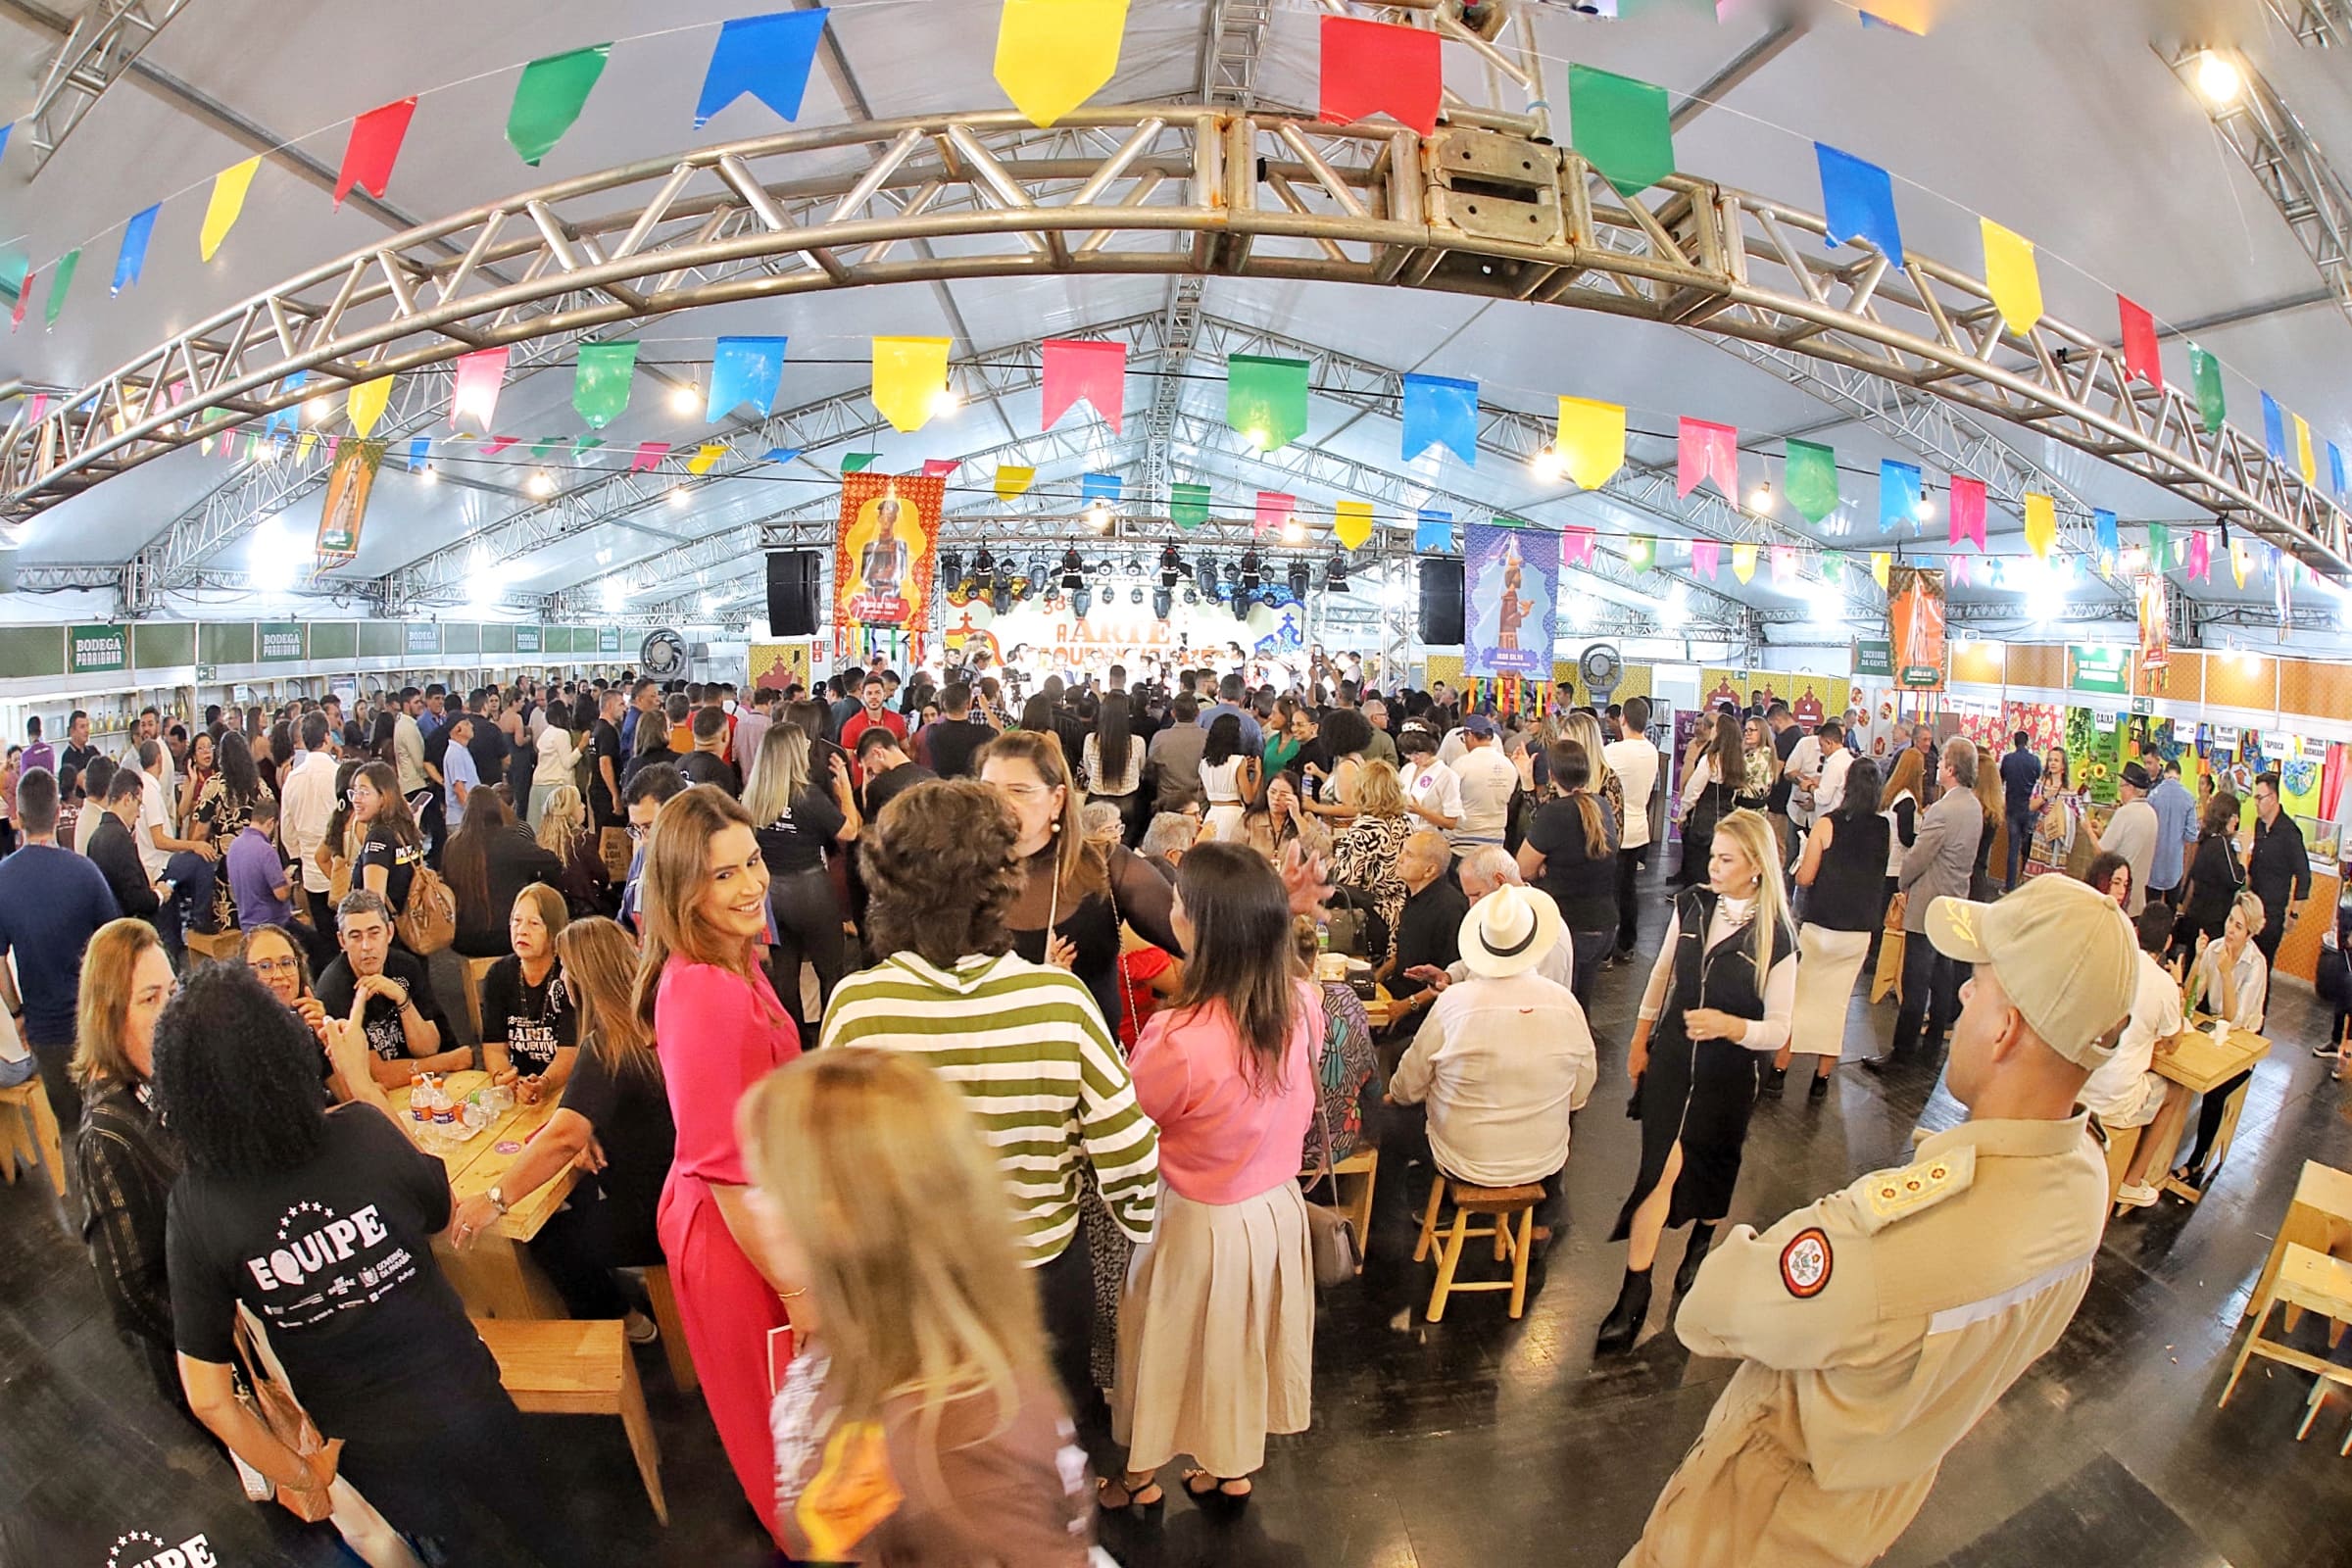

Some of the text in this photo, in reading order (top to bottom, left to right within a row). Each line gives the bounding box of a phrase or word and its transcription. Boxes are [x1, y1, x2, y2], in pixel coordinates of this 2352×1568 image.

[409, 631, 437, 641] BODEGA
[1069, 617, 1171, 645] ARTE
[76, 638, 122, 652] BODEGA
[264, 633, 300, 645] BODEGA
[2095, 712, 2114, 724] CAIXA
[2264, 739, 2283, 751] TAPIOCA
[247, 1203, 388, 1291] EQUIPE
